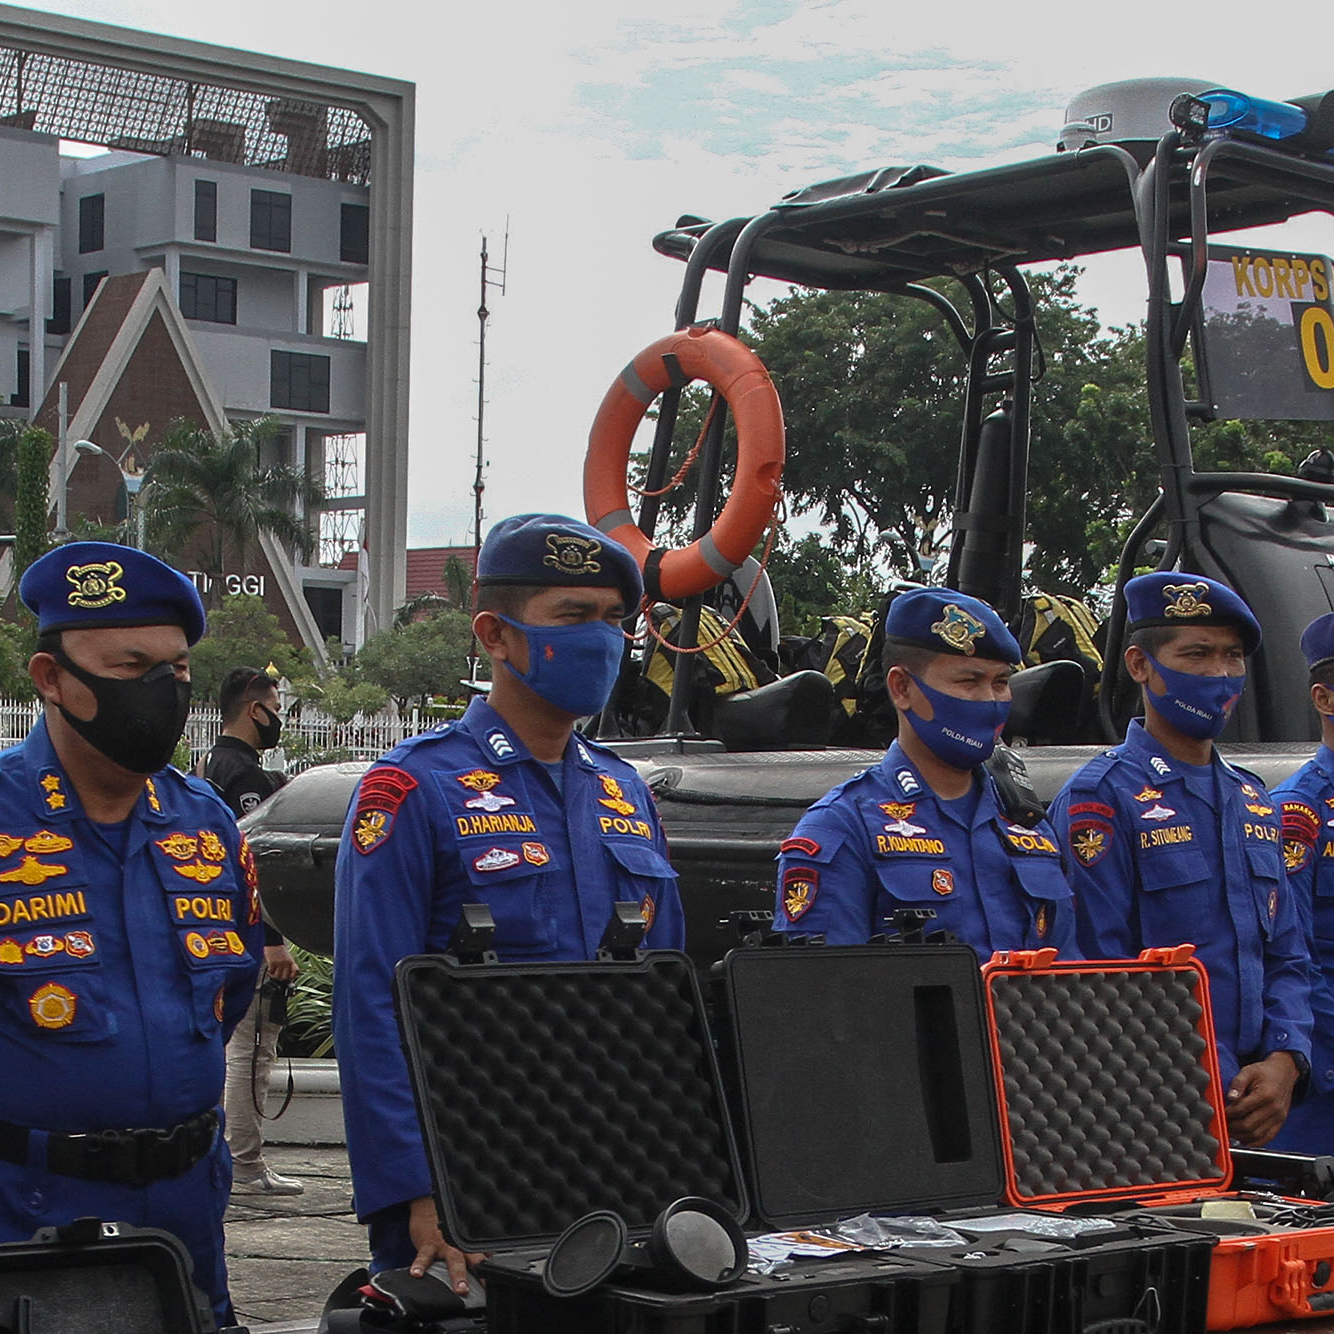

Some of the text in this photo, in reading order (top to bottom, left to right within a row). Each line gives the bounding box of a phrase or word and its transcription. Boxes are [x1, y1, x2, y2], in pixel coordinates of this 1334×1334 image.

[1232, 256, 1329, 300] KORPS
[187, 571, 265, 597] TIGGI
[1175, 699, 1196, 713] POLDA
[941, 727, 983, 749] POLDA RIAU
[457, 813, 536, 836] D.HARIANJA
[599, 816, 652, 841] POLRI
[175, 896, 232, 922] POLRI
